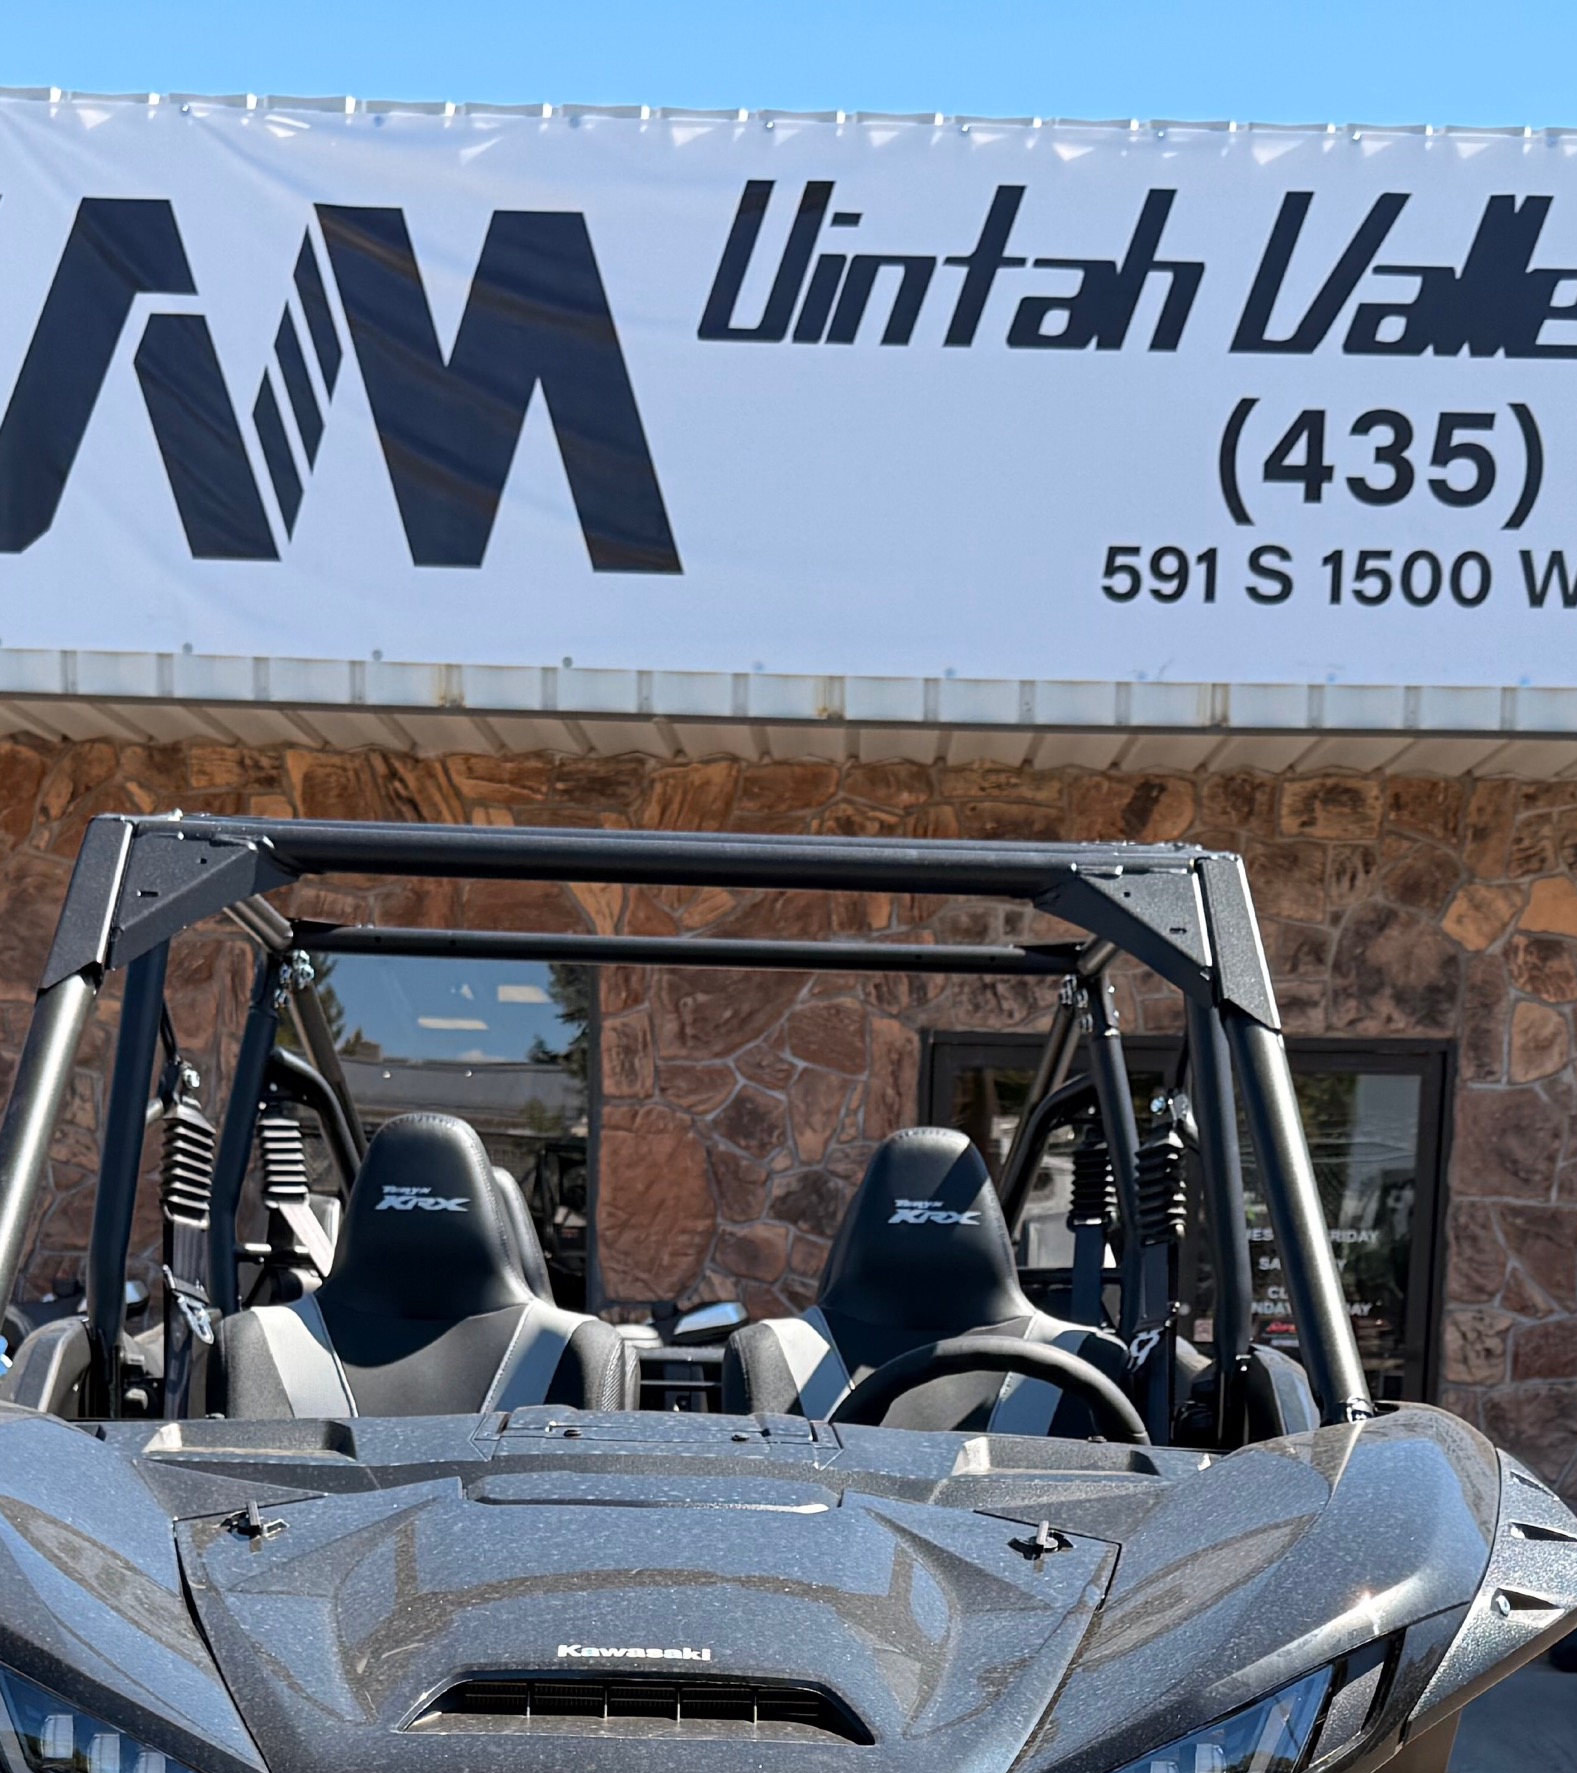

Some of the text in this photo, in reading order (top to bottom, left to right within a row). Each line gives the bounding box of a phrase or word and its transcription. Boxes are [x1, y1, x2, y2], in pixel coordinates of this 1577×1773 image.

[696, 178, 1207, 352] Uintah
[1217, 396, 1545, 531] (435)
[1100, 544, 1219, 605] 591
[1244, 543, 1295, 606] S
[1321, 548, 1493, 609] 1500
[1327, 1229, 1381, 1244] RIDAY
[557, 1644, 712, 1662] Kawasaki
